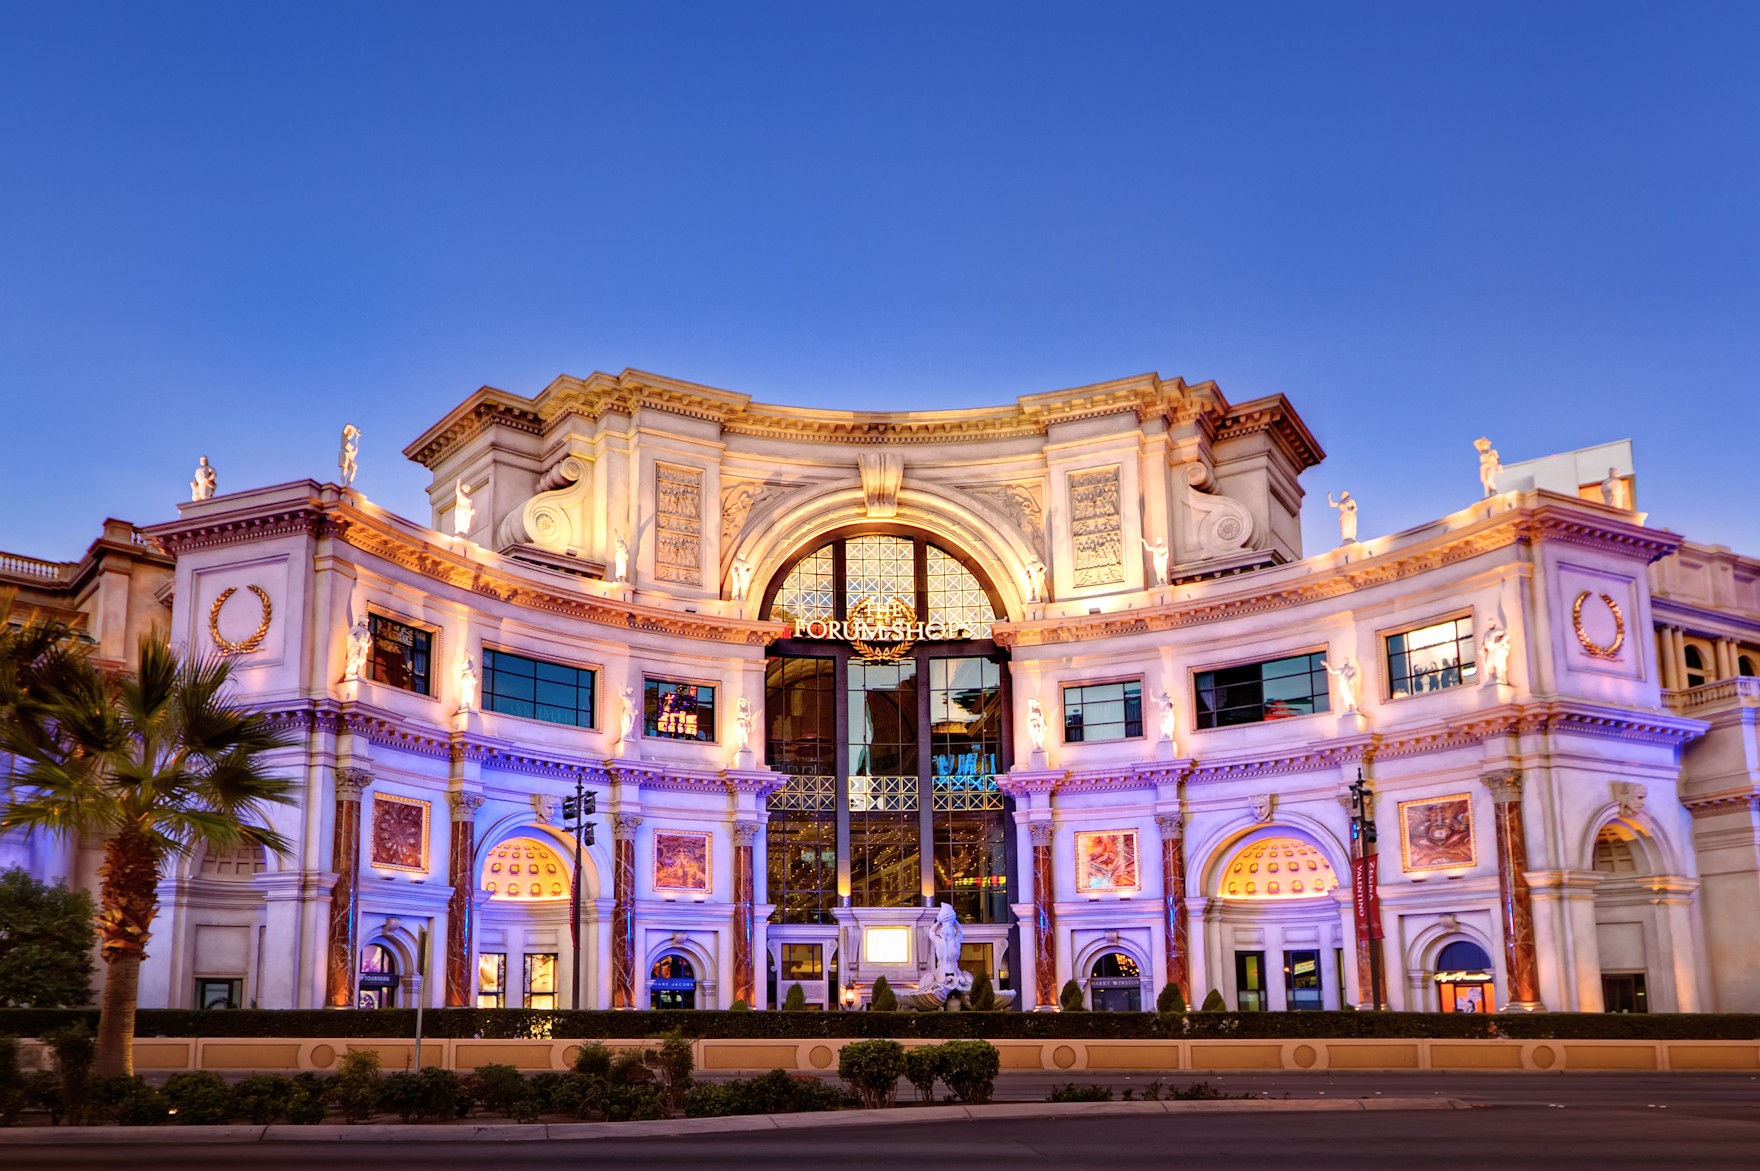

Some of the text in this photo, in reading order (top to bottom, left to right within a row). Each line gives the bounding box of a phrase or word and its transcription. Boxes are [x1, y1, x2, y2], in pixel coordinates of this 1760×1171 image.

[867, 602, 903, 618] THE
[794, 618, 975, 641] FORUM SHOPS
[1356, 864, 1365, 917] VALENTINO
[1368, 861, 1376, 902] ZEGNA
